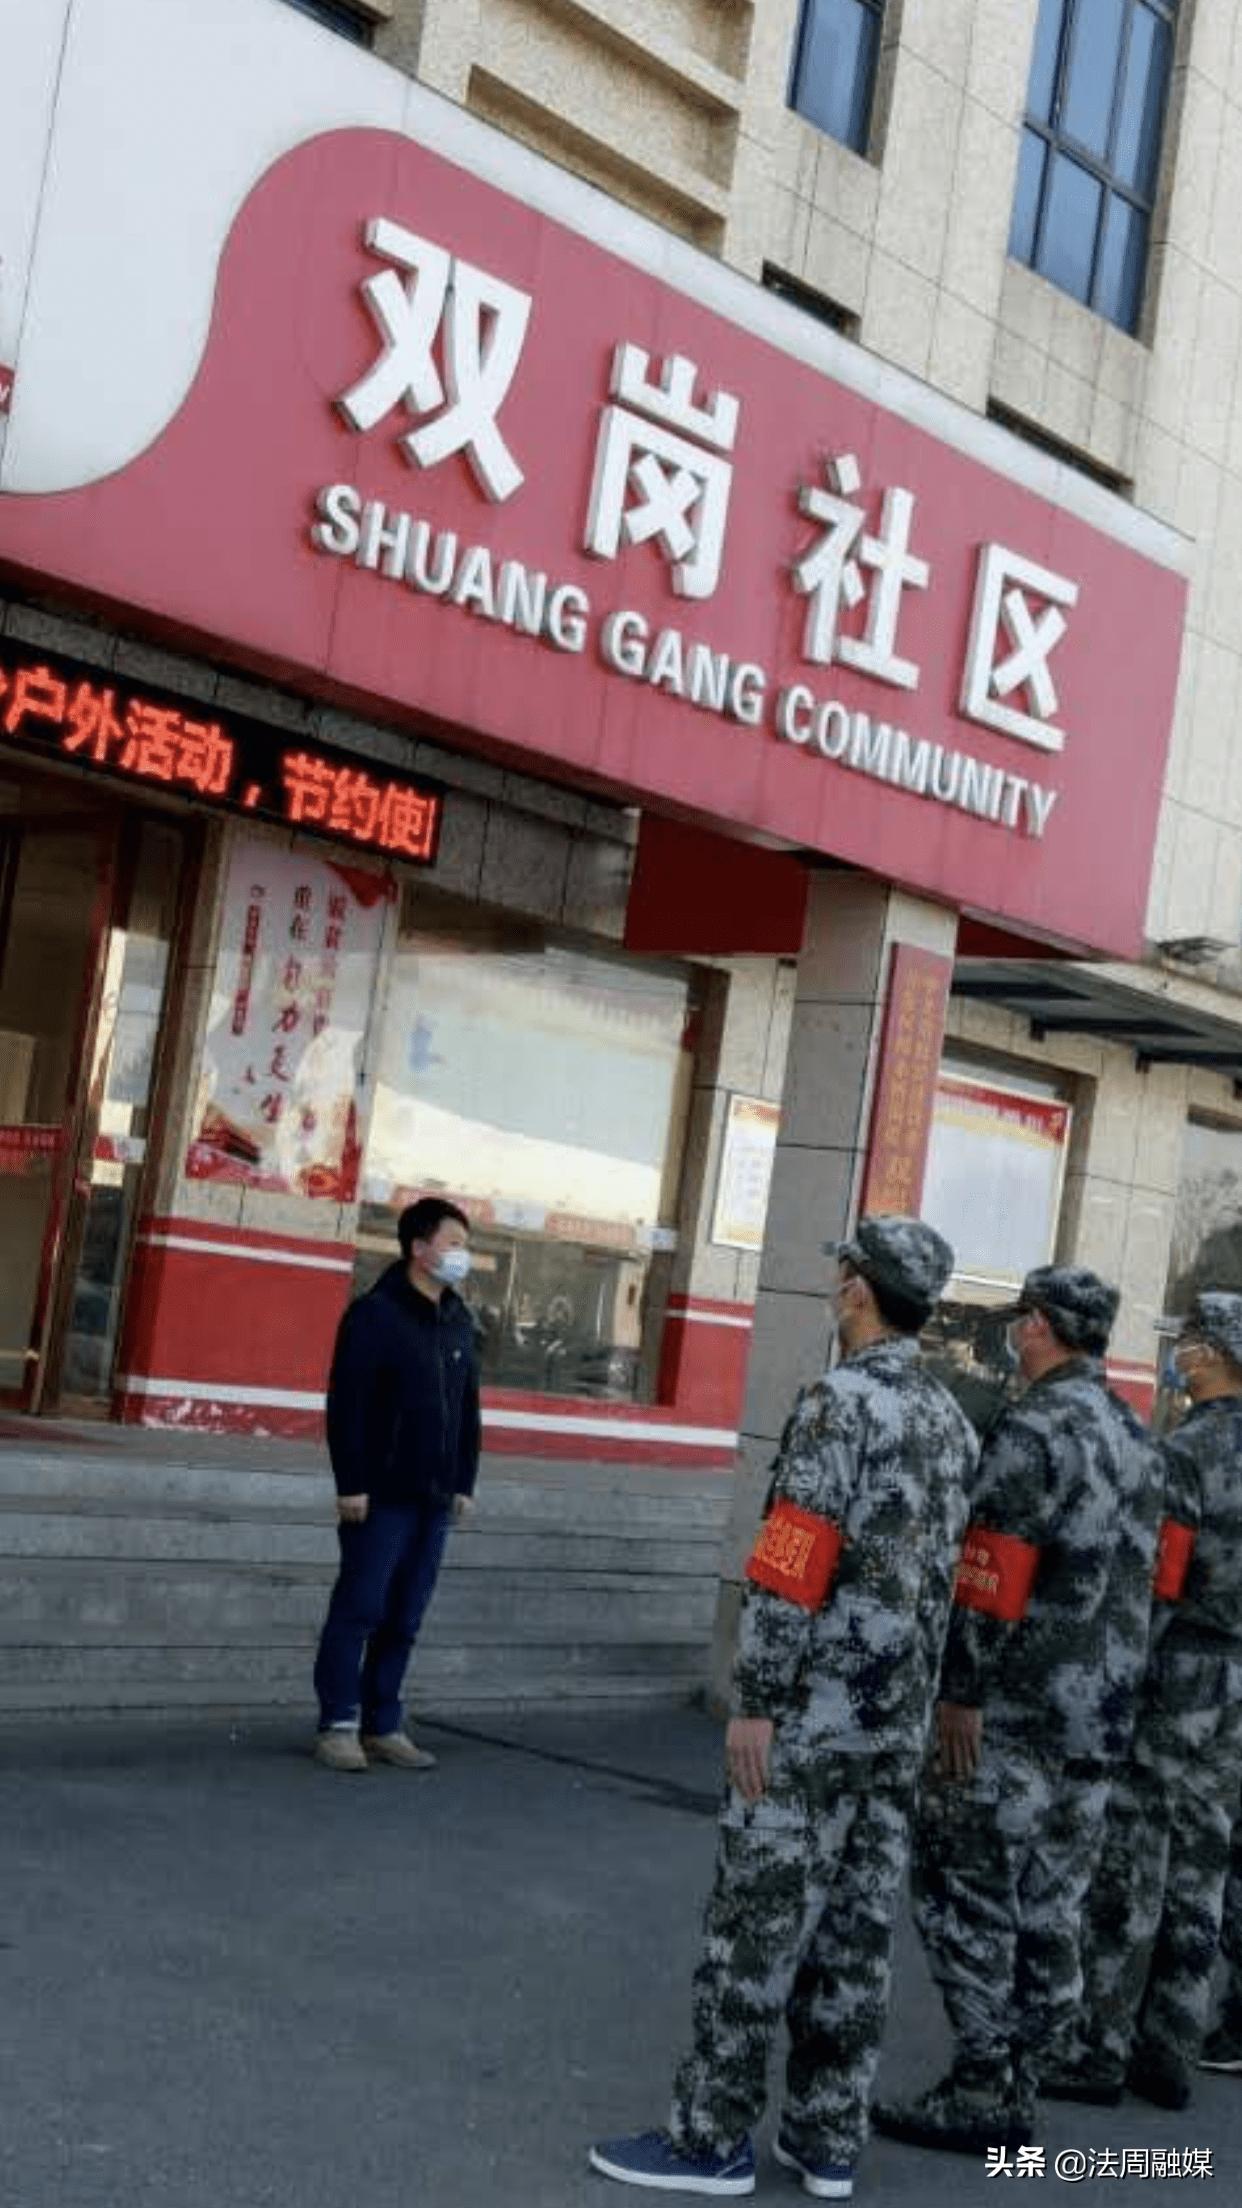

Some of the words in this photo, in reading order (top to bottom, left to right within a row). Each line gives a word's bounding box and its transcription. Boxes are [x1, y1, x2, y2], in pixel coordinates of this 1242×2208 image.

[311, 484, 589, 653] SHUANG
[603, 610, 766, 725] GANG
[776, 685, 1057, 840] COMMUNITY
[334, 217, 1079, 752] 双岗社区
[0, 665, 436, 860] 户外活动，节约使
